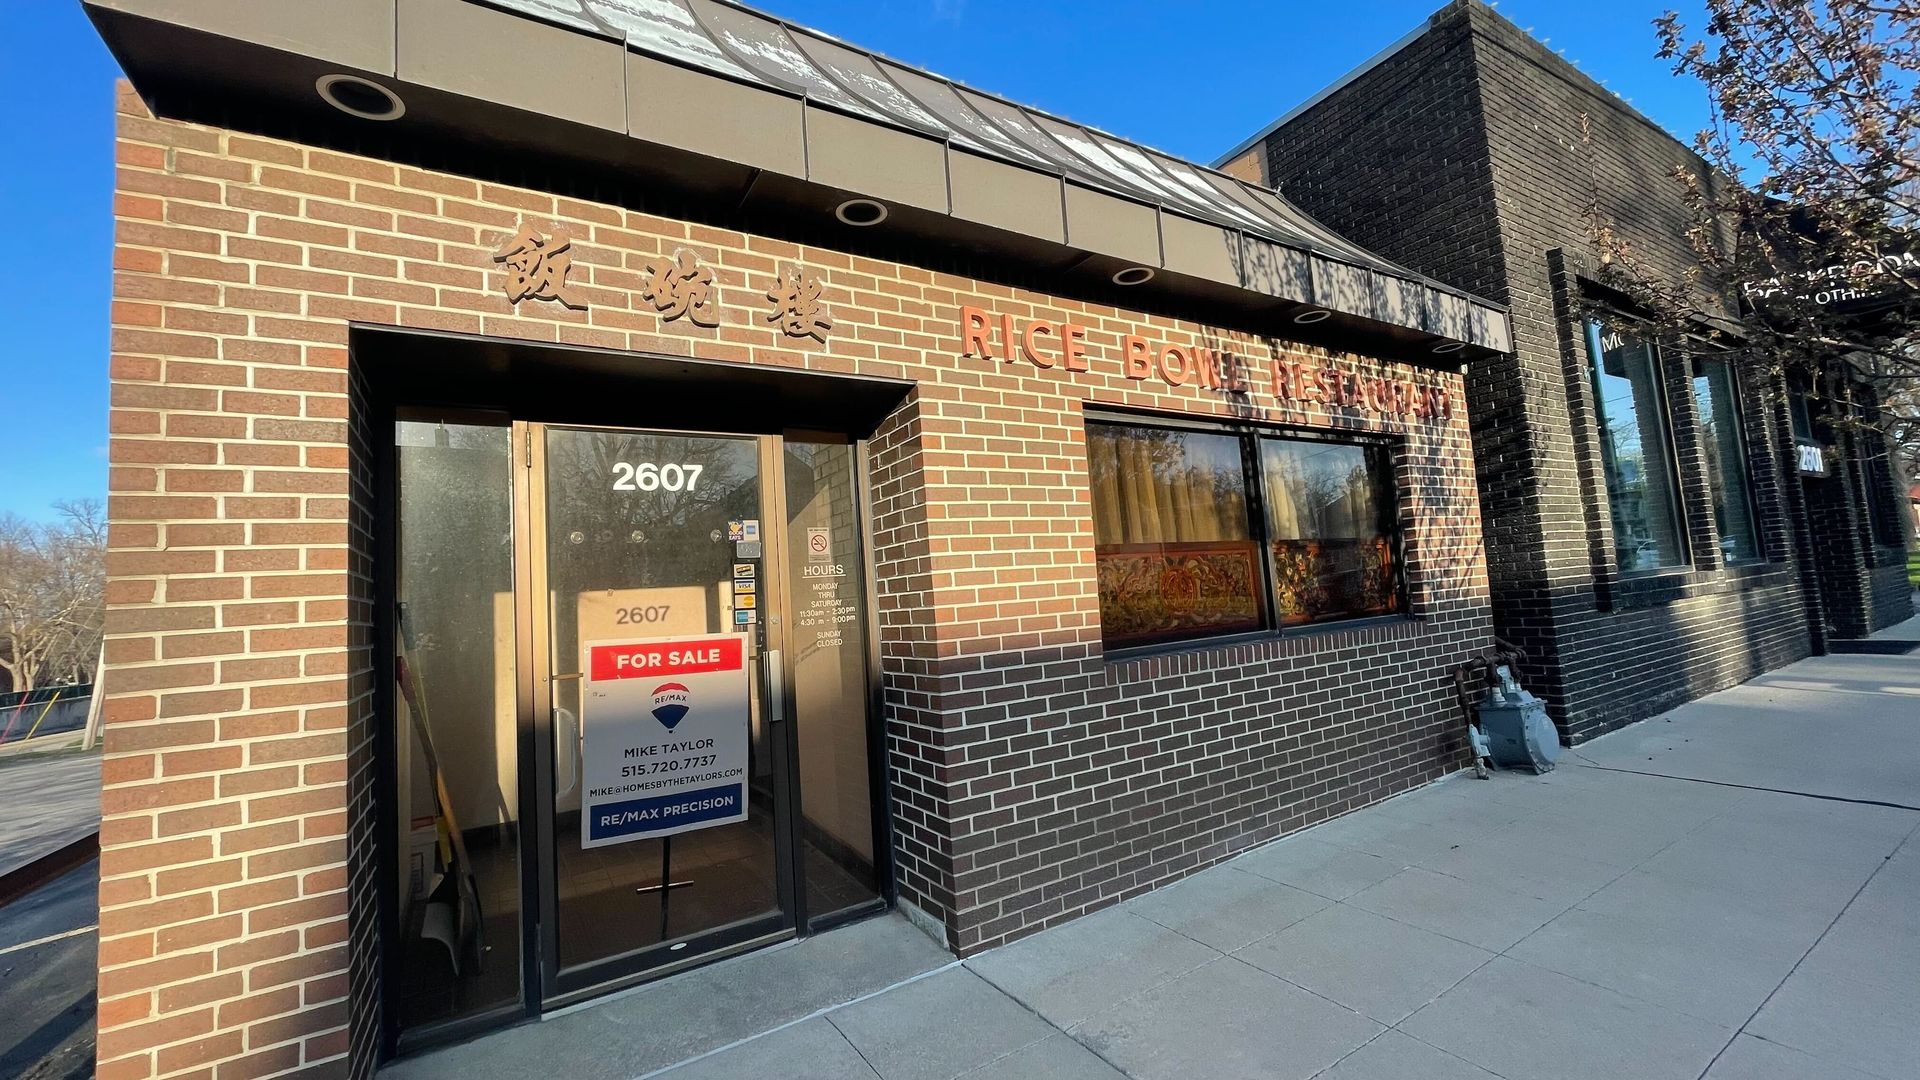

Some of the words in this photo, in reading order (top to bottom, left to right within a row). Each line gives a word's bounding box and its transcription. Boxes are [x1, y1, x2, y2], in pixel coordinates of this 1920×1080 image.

[960, 305, 1089, 373] RICE
[1122, 334, 1250, 395] BOWL
[1269, 357, 1452, 420] RESTAURANT
[612, 462, 703, 491] 2607
[804, 564, 844, 576] HOURS
[812, 582, 839, 591] MONDAY
[818, 591, 835, 599] THRU
[810, 599, 842, 608] SATURDAY
[616, 605, 670, 625] 2607
[816, 630, 842, 640] SUNDAY
[816, 638, 843, 648] CLOSED
[616, 652, 661, 669] FOR
[668, 648, 721, 666] SALE
[654, 694, 687, 705] RE/MAX
[624, 746, 657, 758] MIKE
[663, 738, 714, 754] TAYLOR
[621, 754, 717, 778] 515.720.7737
[589, 767, 743, 798] MIKE@HOMESBYTHETAYLORS.COM
[600, 808, 659, 827] RE/MAX
[663, 795, 734, 817] PRECISION
